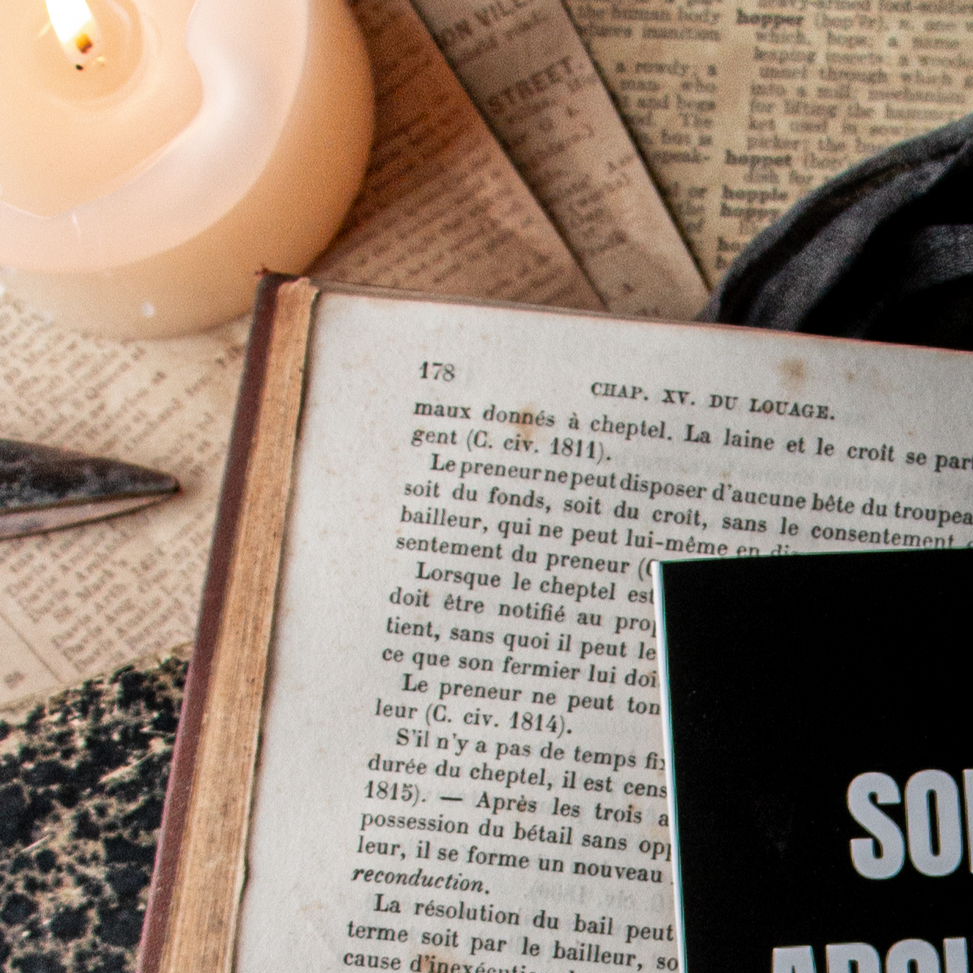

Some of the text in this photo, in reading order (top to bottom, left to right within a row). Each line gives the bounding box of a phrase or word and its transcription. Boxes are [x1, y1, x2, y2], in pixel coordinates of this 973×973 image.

[736, 7, 804, 29] hopper
[420, 360, 456, 382] 178
[590, 381, 836, 421] CHAP. XV. DU LOUAGE.
[410, 428, 612, 464] gent (C. civ. 1811).
[413, 402, 471, 420] maux
[482, 403, 556, 428] donnés
[567, 412, 580, 431] à
[589, 414, 673, 441] cheptel.
[683, 423, 712, 445] La
[723, 427, 775, 451] laine
[785, 436, 806, 454] et
[815, 436, 835, 457] le
[905, 451, 928, 466] se
[415, 561, 654, 605] Lorsque le cheptel est
[386, 616, 657, 661] tient, sans quoi il peut le
[375, 697, 573, 739] leur (C. civ. 1814).
[360, 813, 628, 852] possession du bétail sans
[357, 834, 663, 884] leur, il se forme un nouveau
[351, 867, 490, 895] reconduction.
[373, 892, 674, 945] La résolution du bail peut
